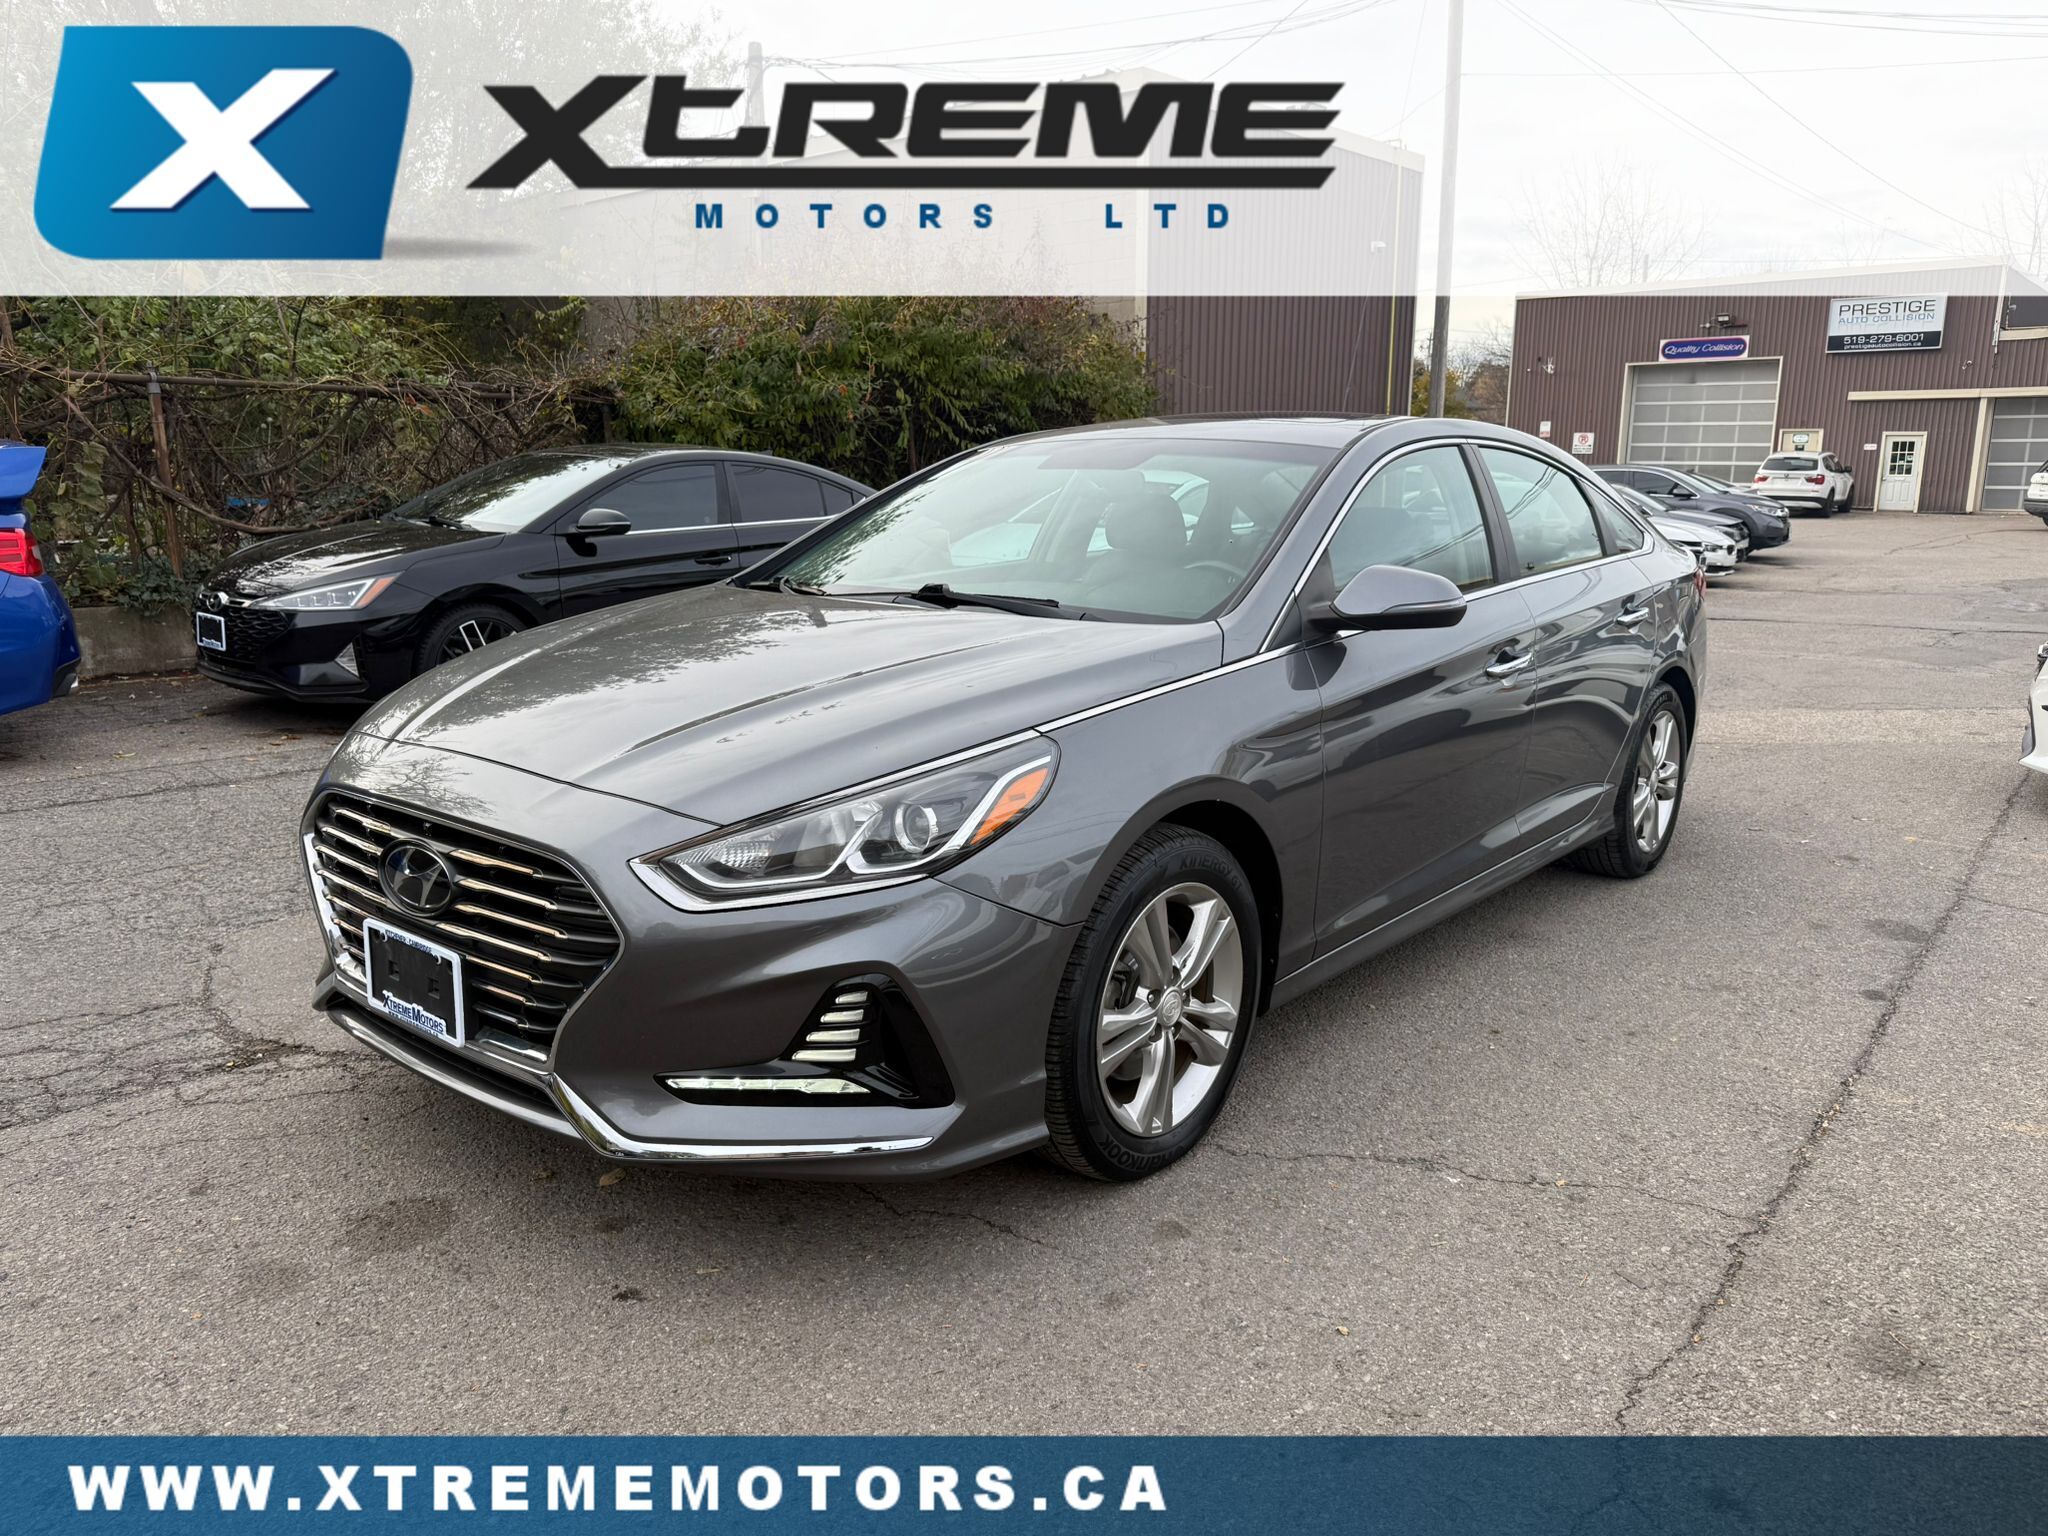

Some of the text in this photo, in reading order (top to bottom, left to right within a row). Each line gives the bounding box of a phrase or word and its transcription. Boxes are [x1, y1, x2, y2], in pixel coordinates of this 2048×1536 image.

[1838, 299, 1937, 317] PRESTIGE
[1838, 312, 1936, 325] AUTO COLLISION
[1843, 333, 1925, 345] 519-279-6001
[1664, 342, 1745, 355] Quality Collision
